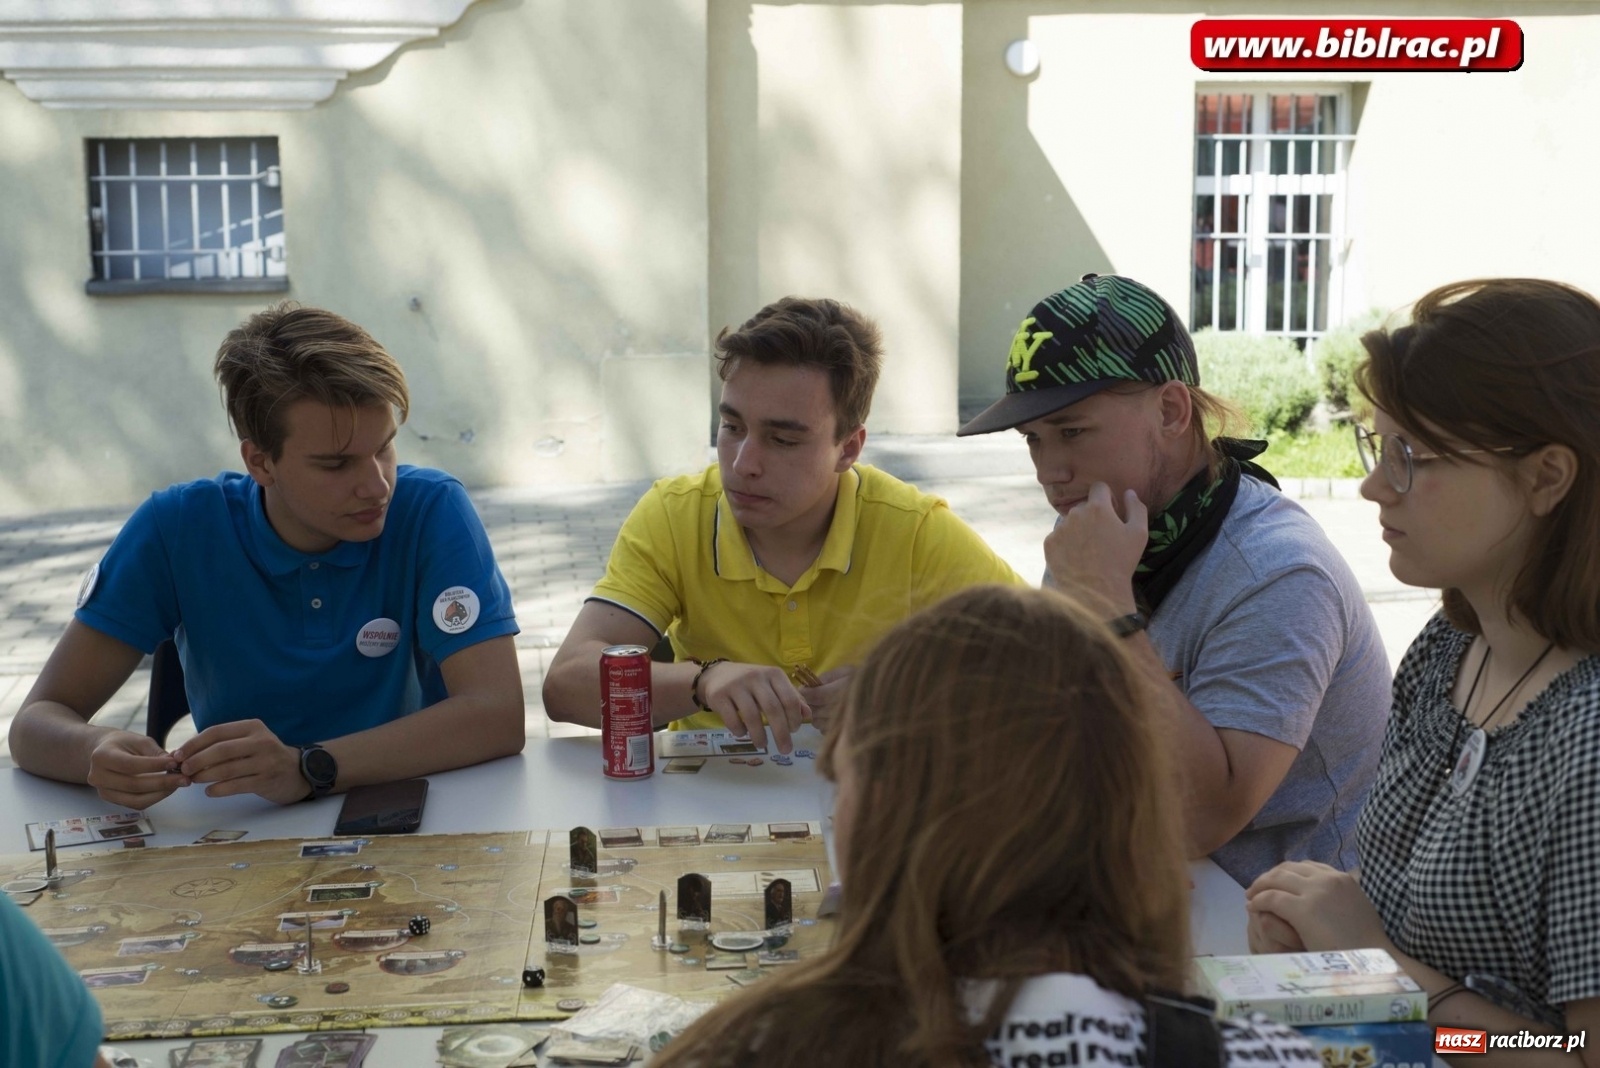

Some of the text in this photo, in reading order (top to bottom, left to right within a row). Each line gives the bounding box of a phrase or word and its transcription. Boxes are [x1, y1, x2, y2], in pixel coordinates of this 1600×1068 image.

[362, 630, 399, 641] WSPÓLNIE
[1284, 1003, 1301, 1022] NO
[1008, 1013, 1074, 1041] real
[1011, 1042, 1079, 1068] real
